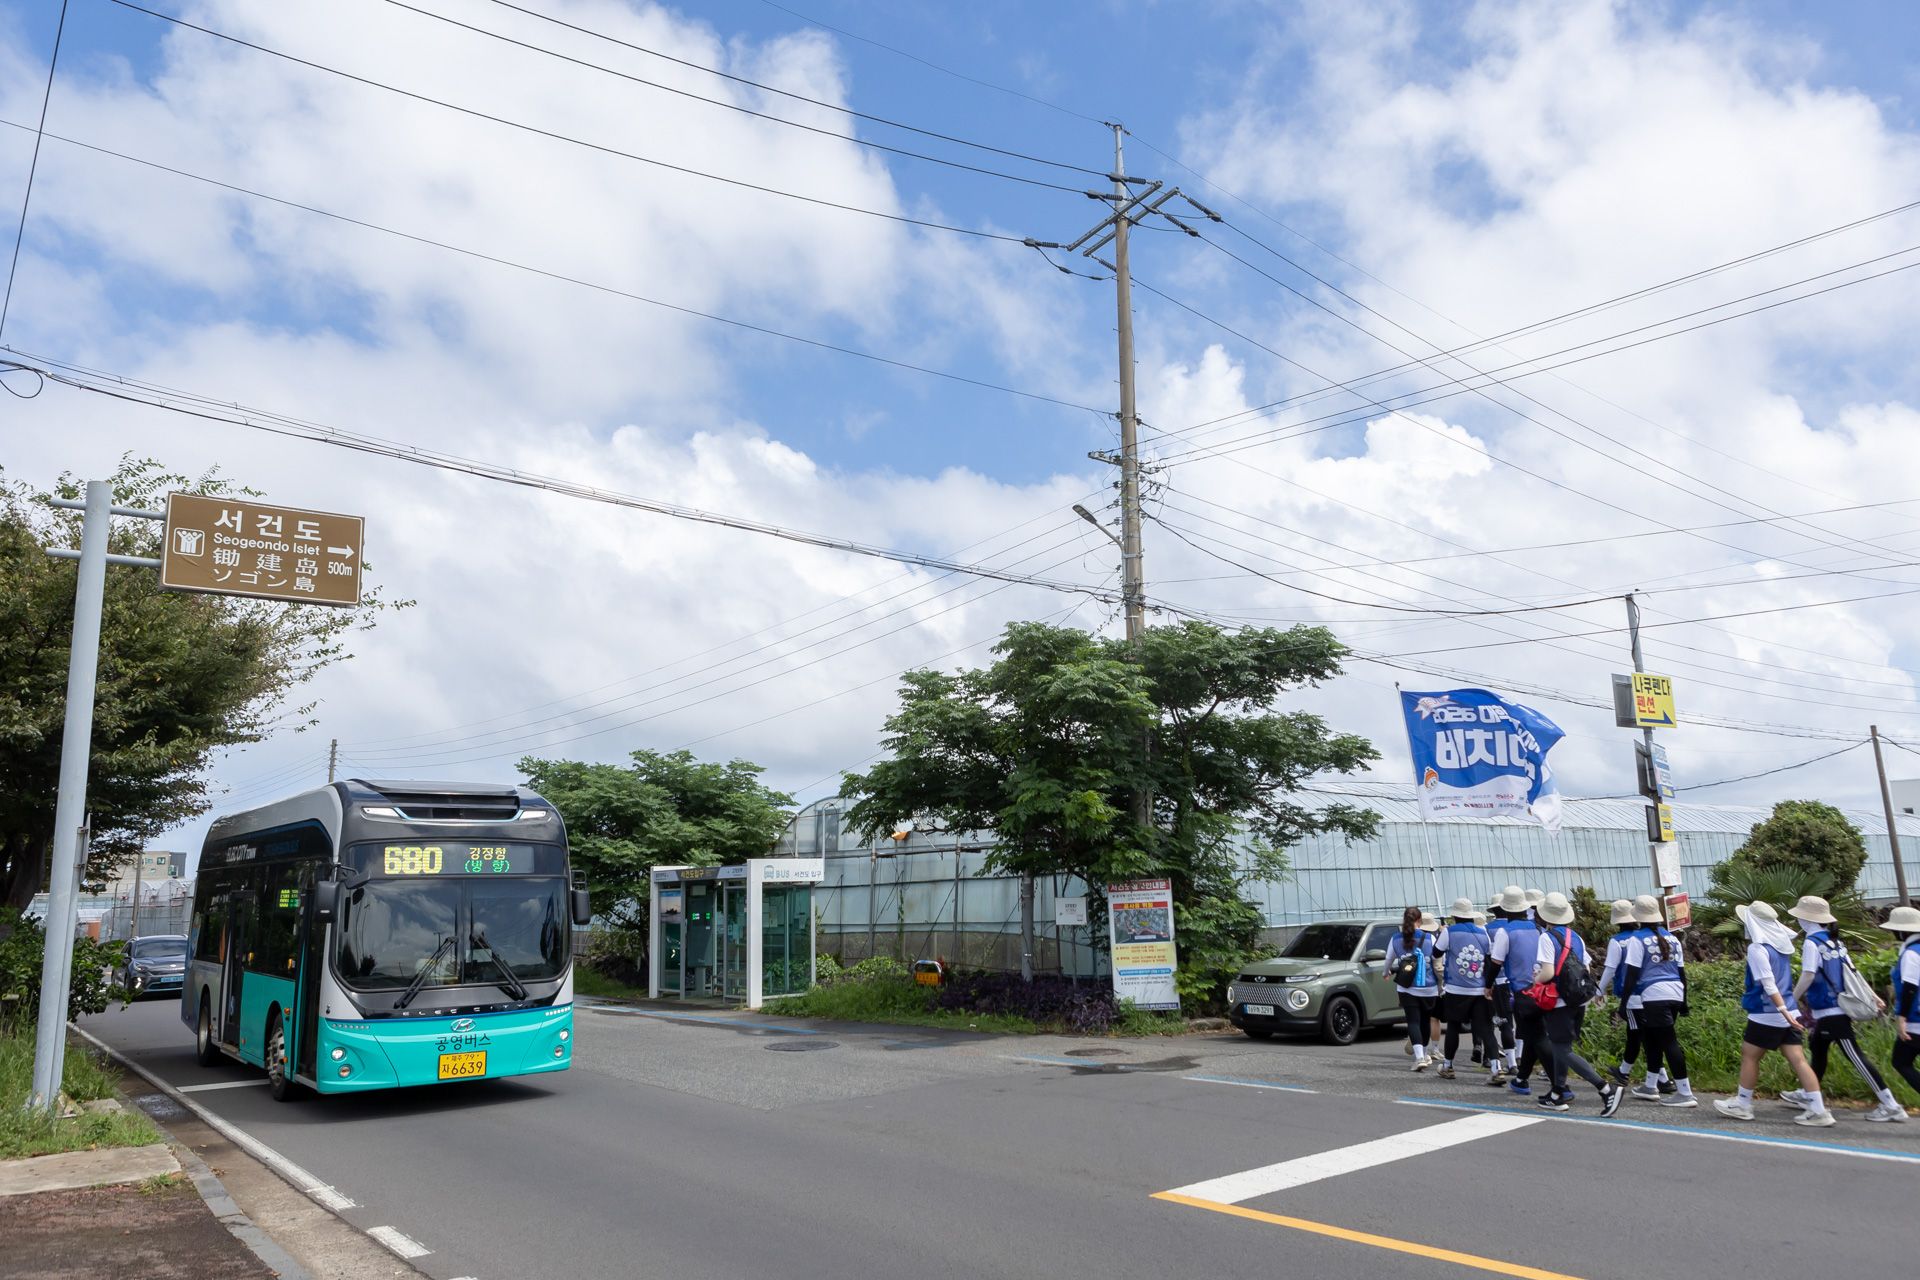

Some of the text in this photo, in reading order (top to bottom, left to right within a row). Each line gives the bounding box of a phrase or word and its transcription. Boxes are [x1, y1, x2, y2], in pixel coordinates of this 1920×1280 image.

[214, 509, 322, 542] 서건도
[213, 532, 320, 556] Seogeondo Islet
[328, 562, 352, 576] 500m
[213, 568, 316, 593] ソゴン島
[1634, 676, 1670, 696] 나쿠펜다
[1636, 696, 1656, 714] 펜션
[384, 846, 443, 875] 680
[776, 870, 790, 878] BUS
[434, 1034, 492, 1052] 공영버스
